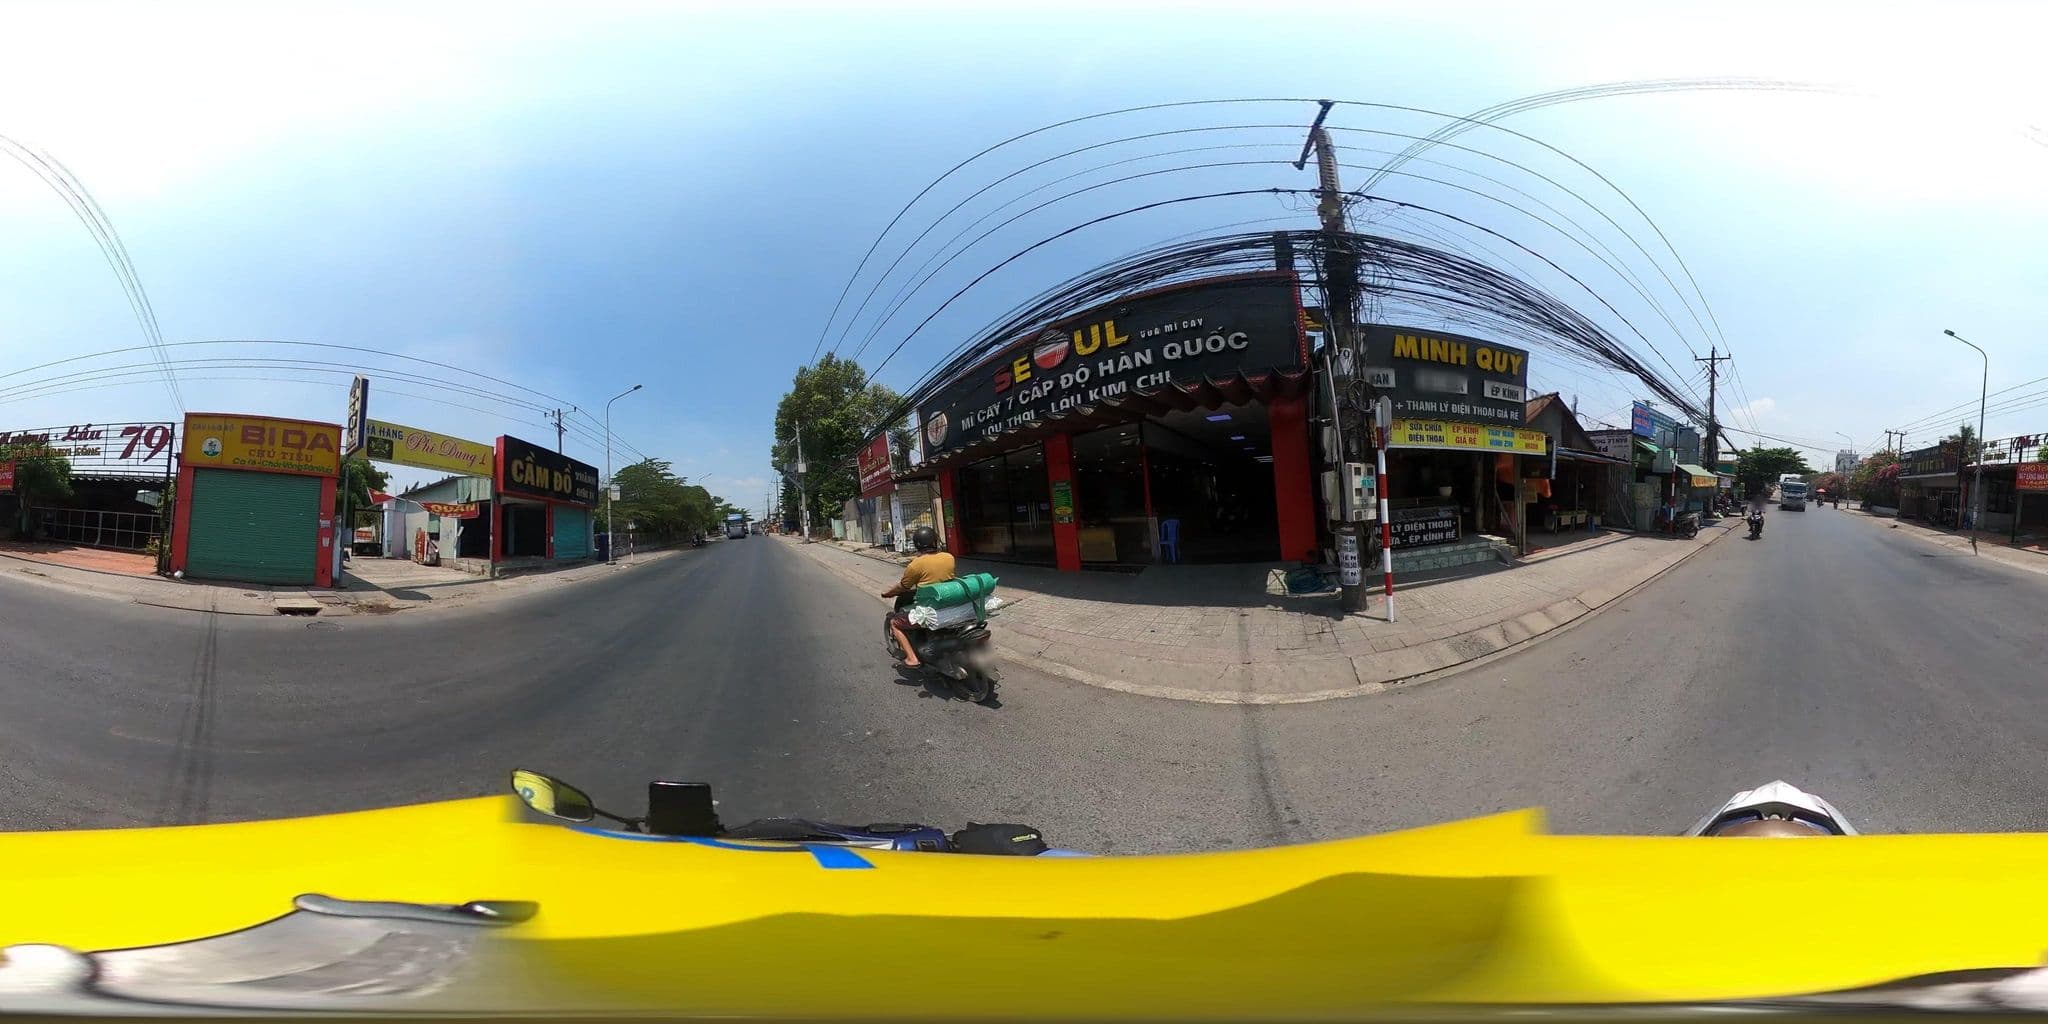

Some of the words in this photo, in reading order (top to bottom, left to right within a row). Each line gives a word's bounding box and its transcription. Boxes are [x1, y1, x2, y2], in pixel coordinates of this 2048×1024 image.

[1394, 334, 1467, 366] MINH
[977, 401, 1001, 422] CAY
[1006, 395, 1016, 410] 7
[1018, 377, 1055, 404] CẤP
[1060, 363, 1091, 389] ĐỘ
[1098, 350, 1153, 378] HÀN
[1163, 326, 1249, 360] QUỐC
[1089, 381, 1127, 401] KIM
[1137, 370, 1171, 389] CHI
[1406, 400, 1437, 412] THANH
[1440, 400, 1449, 412] LÝ
[1451, 402, 1470, 416] ĐIỆN
[1472, 406, 1495, 418] THOẠI
[119, 425, 170, 462] 79
[511, 451, 550, 489] CẦM
[553, 463, 572, 494] ĐỒ
[1428, 520, 1452, 529] THOẠI
